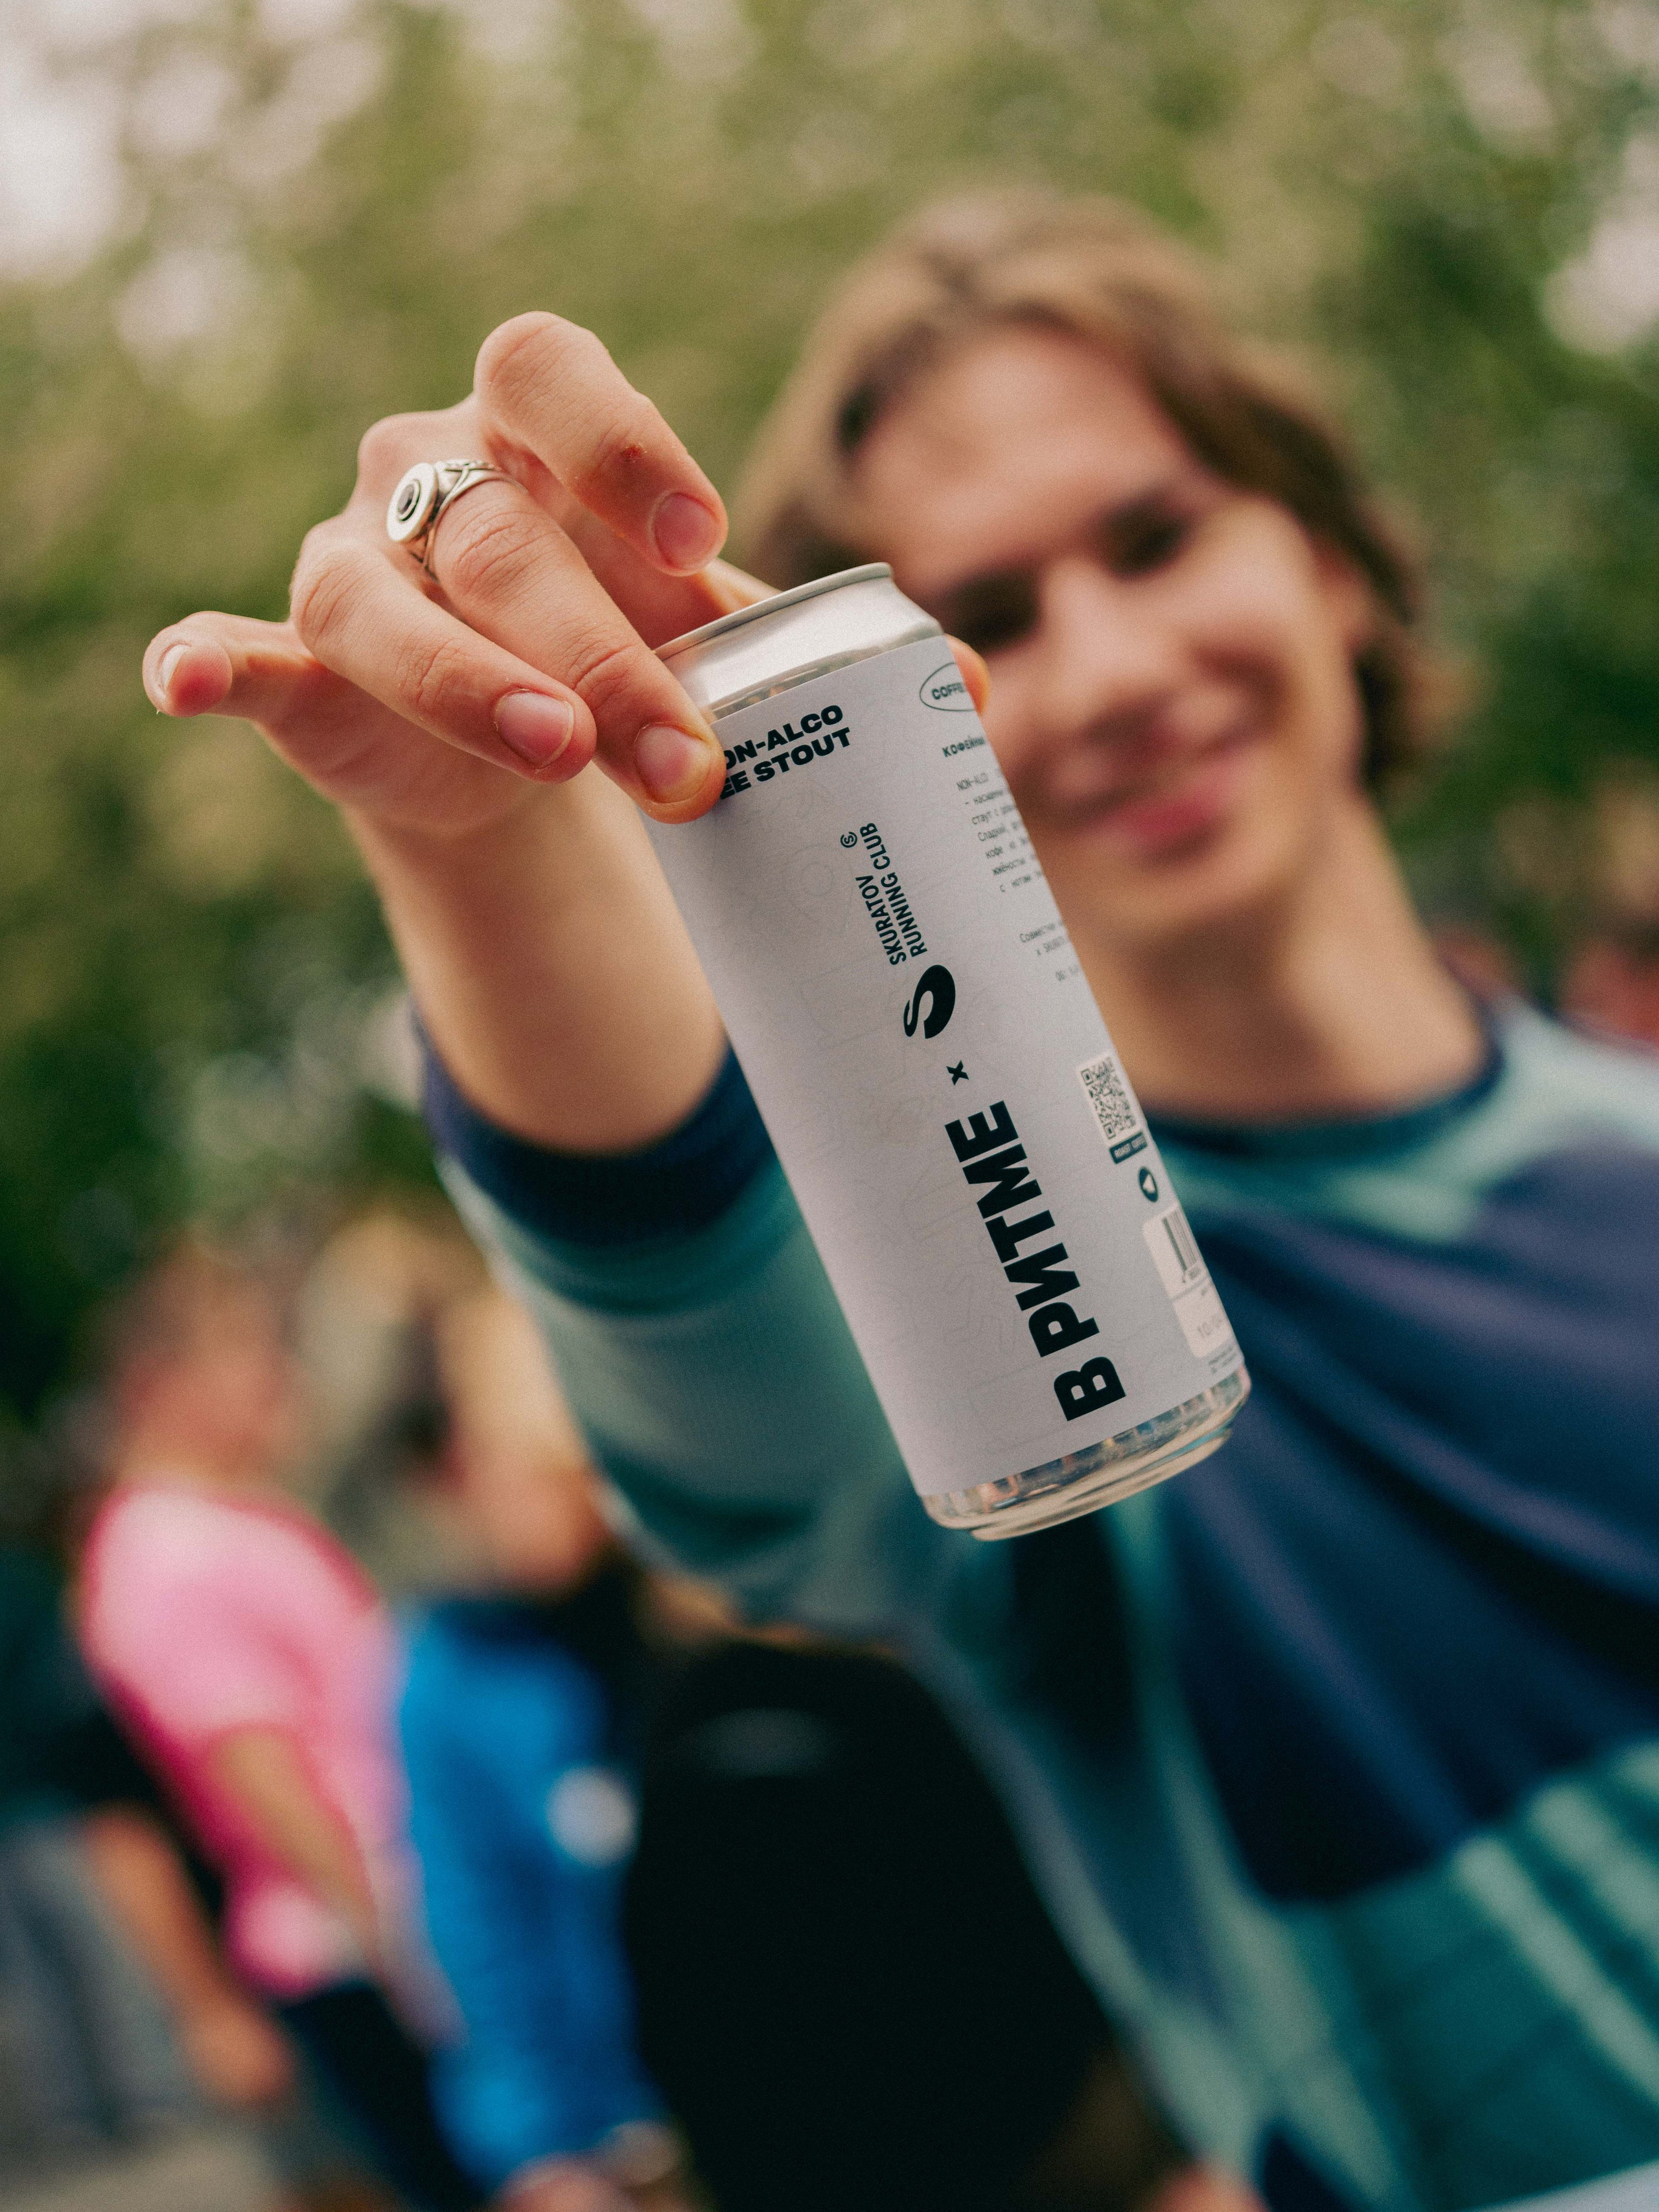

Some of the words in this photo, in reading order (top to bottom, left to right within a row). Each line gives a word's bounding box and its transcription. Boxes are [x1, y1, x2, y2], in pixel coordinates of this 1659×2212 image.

[723, 704, 843, 770] ON-ALCO
[753, 727, 850, 782] STOUT
[859, 822, 890, 870] CLUB
[855, 875, 907, 966] SKURATOV
[881, 872, 928, 957] RUNNING
[944, 1099, 1100, 1358] РИТМЕ
[1053, 1356, 1126, 1422] В
